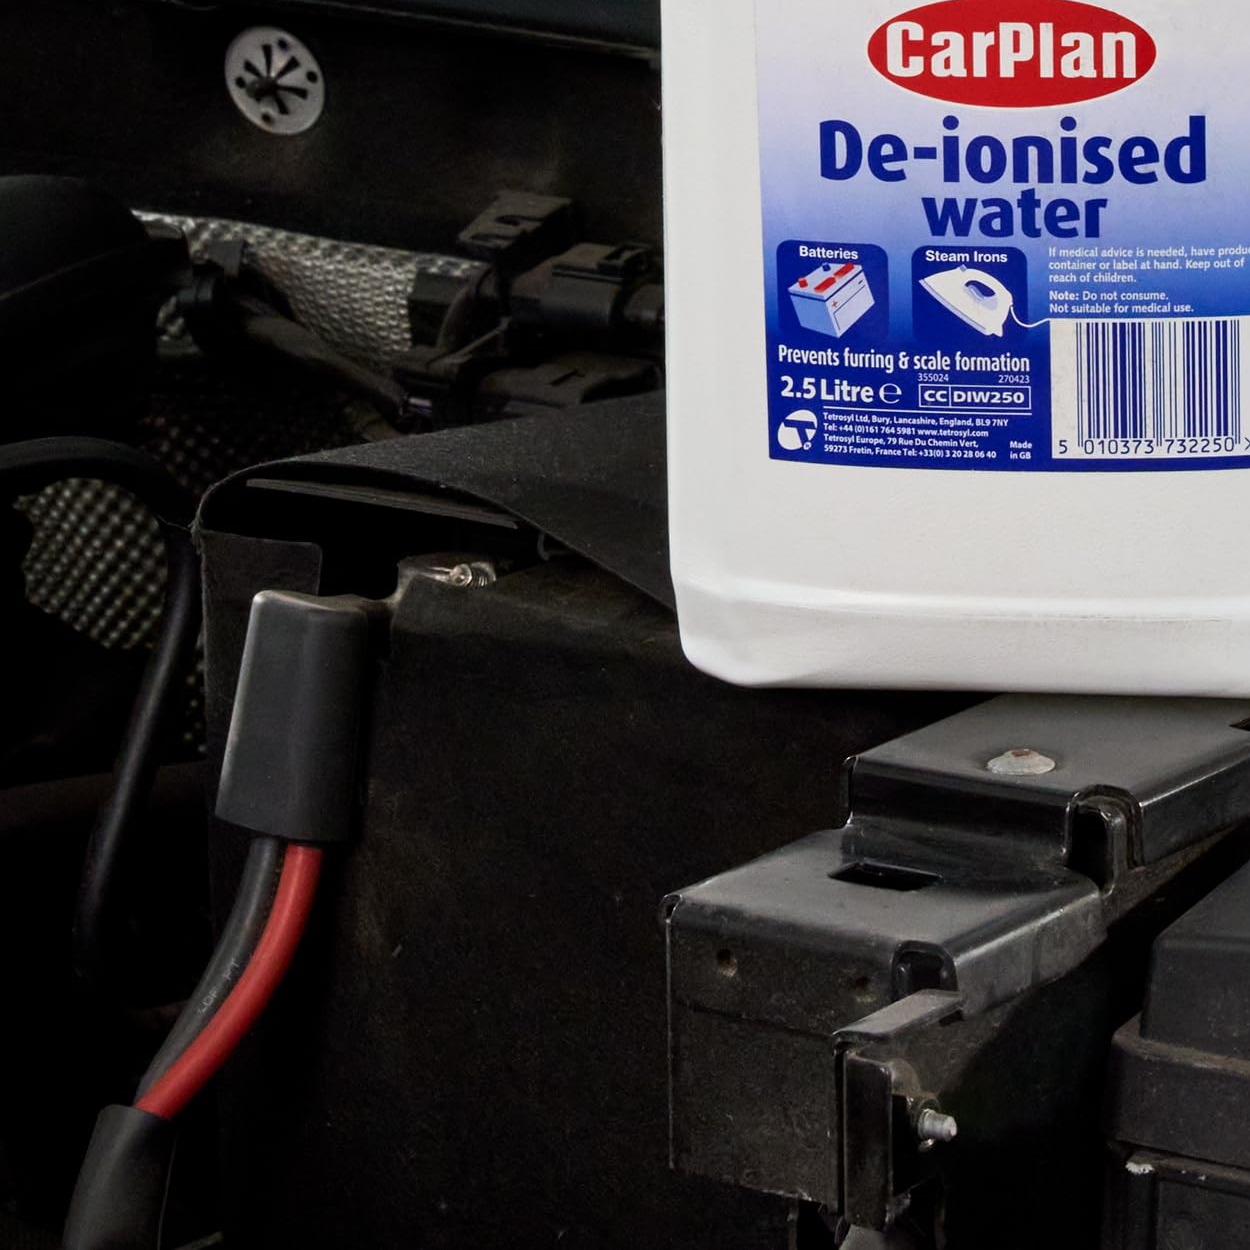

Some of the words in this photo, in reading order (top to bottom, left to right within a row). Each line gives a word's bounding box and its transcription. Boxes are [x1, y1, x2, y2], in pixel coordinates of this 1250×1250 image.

[886, 21, 1136, 78] CarPlan
[819, 115, 1206, 184] De-ionised
[922, 188, 1108, 238] water
[799, 246, 858, 259] Batteries
[926, 250, 969, 262] Steam
[974, 251, 1007, 263] Irons
[1049, 247, 1056, 257] If
[1059, 247, 1097, 257] medical
[1101, 247, 1133, 257] advice
[1137, 247, 1144, 256] is
[1148, 246, 1187, 257] needed,
[1191, 246, 1215, 256] have
[1049, 260, 1096, 269] container
[1114, 260, 1137, 269] label
[1140, 260, 1150, 269] at
[1154, 259, 1182, 269] hand.
[1186, 259, 1210, 270] Keep
[1213, 259, 1230, 268] out
[1234, 257, 1245, 267] of
[1049, 272, 1076, 282] reach
[1080, 272, 1091, 282] of
[1093, 272, 1136, 282] children.
[1049, 291, 1079, 300] Note:
[1083, 291, 1097, 300] Do
[1101, 291, 1117, 300] not
[1121, 292, 1168, 300] consume.
[1049, 303, 1068, 313] Not
[1072, 303, 1110, 313] suitable
[1114, 303, 1129, 312] for
[1132, 302, 1170, 312] medical
[778, 345, 839, 366] Prevents
[845, 348, 893, 373] furring
[899, 353, 908, 369] &
[914, 351, 950, 370] scale
[955, 353, 1030, 371] formation
[918, 373, 949, 381] 355024
[998, 375, 1030, 383] 270423
[781, 376, 816, 399] 2.5
[821, 379, 874, 402] Litre
[924, 390, 947, 402] CC
[954, 391, 1024, 403] DIW250
[823, 412, 854, 423] Tetrosyl
[855, 414, 870, 423] Ltd,
[872, 415, 892, 424] Bury,
[894, 416, 938, 425] Lancashire,
[939, 418, 974, 427] England,
[855, 425, 878, 433] (0)161
[918, 429, 988, 438] www.tetrosyl.com
[824, 434, 854, 444] Tetrosyl
[856, 436, 885, 445] Europe,
[927, 439, 958, 447] Chemin
[1010, 441, 1032, 449] Made
[1059, 440, 1067, 454] 5
[1084, 438, 1154, 454] 010373
[1166, 437, 1234, 454] 732250
[849, 446, 874, 455] Fretin,
[875, 447, 901, 455] France
[919, 449, 943, 458] +33(0)
